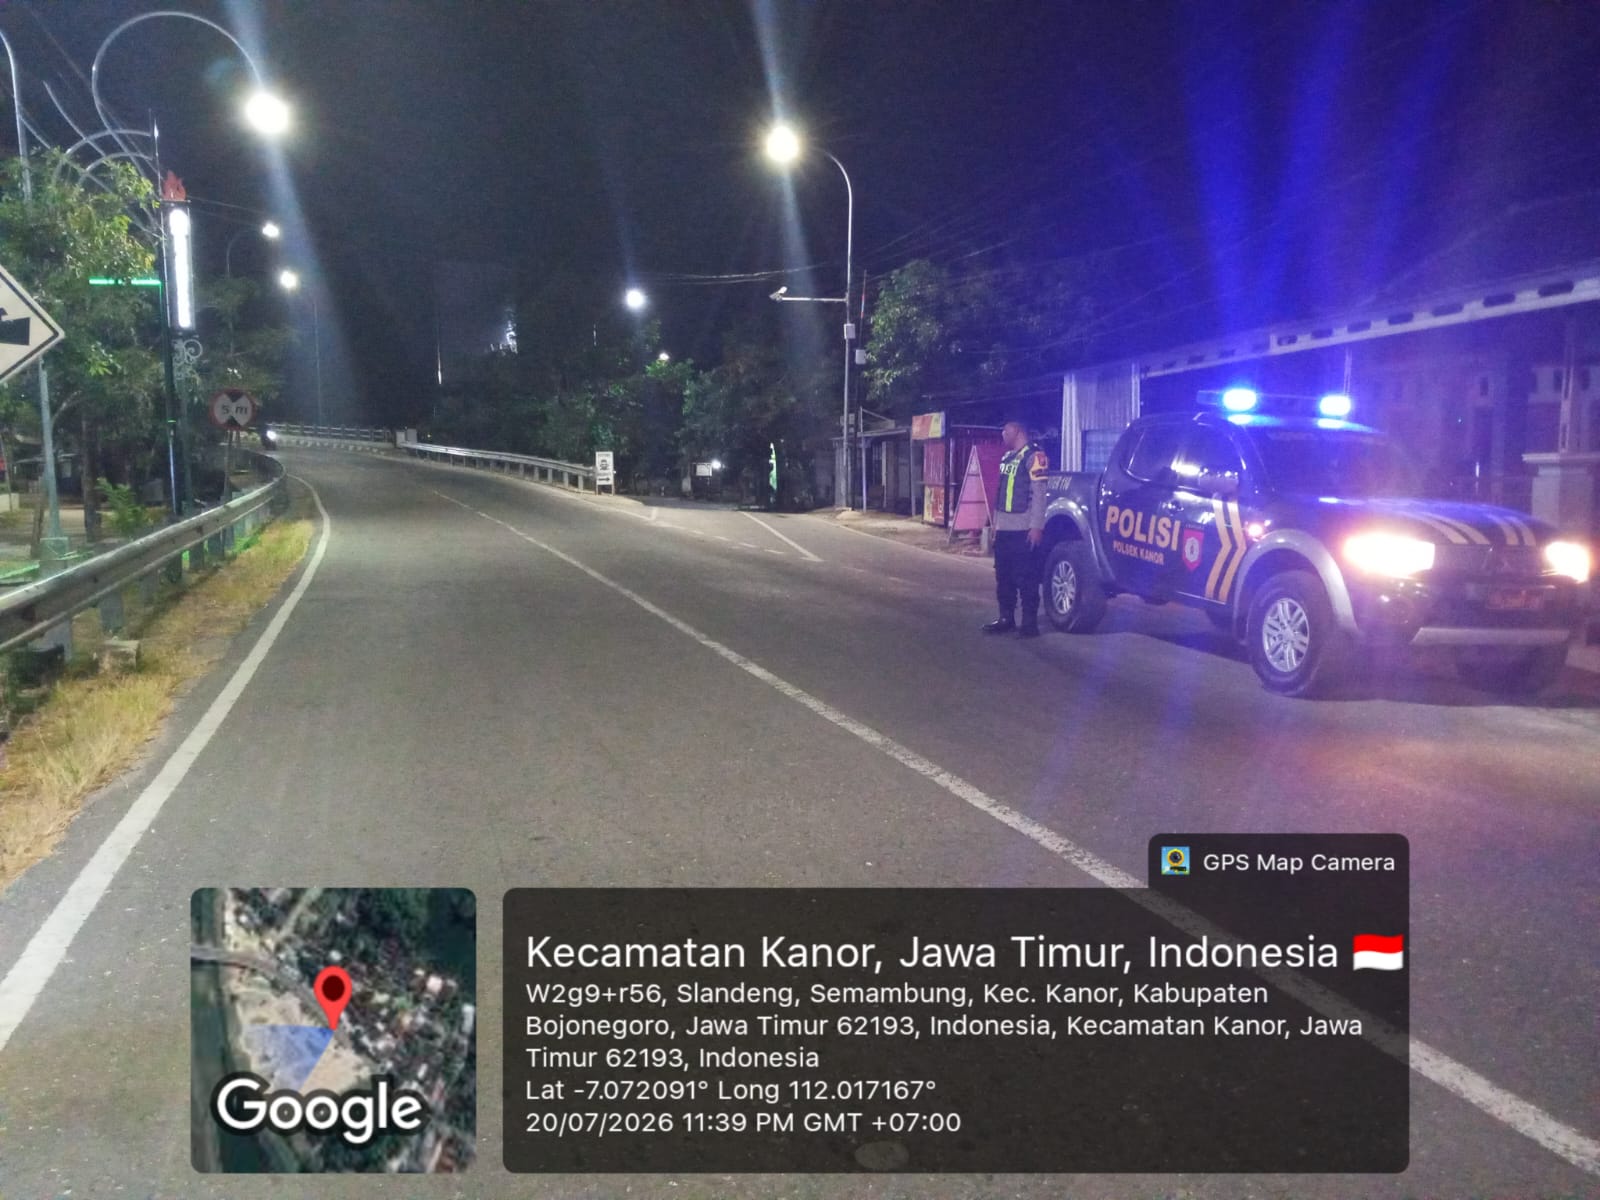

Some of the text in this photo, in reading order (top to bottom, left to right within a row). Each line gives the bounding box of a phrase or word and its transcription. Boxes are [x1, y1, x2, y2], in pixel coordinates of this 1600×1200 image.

[1105, 505, 1181, 551] POLISI
[1113, 540, 1164, 566] POLSEK KANOR
